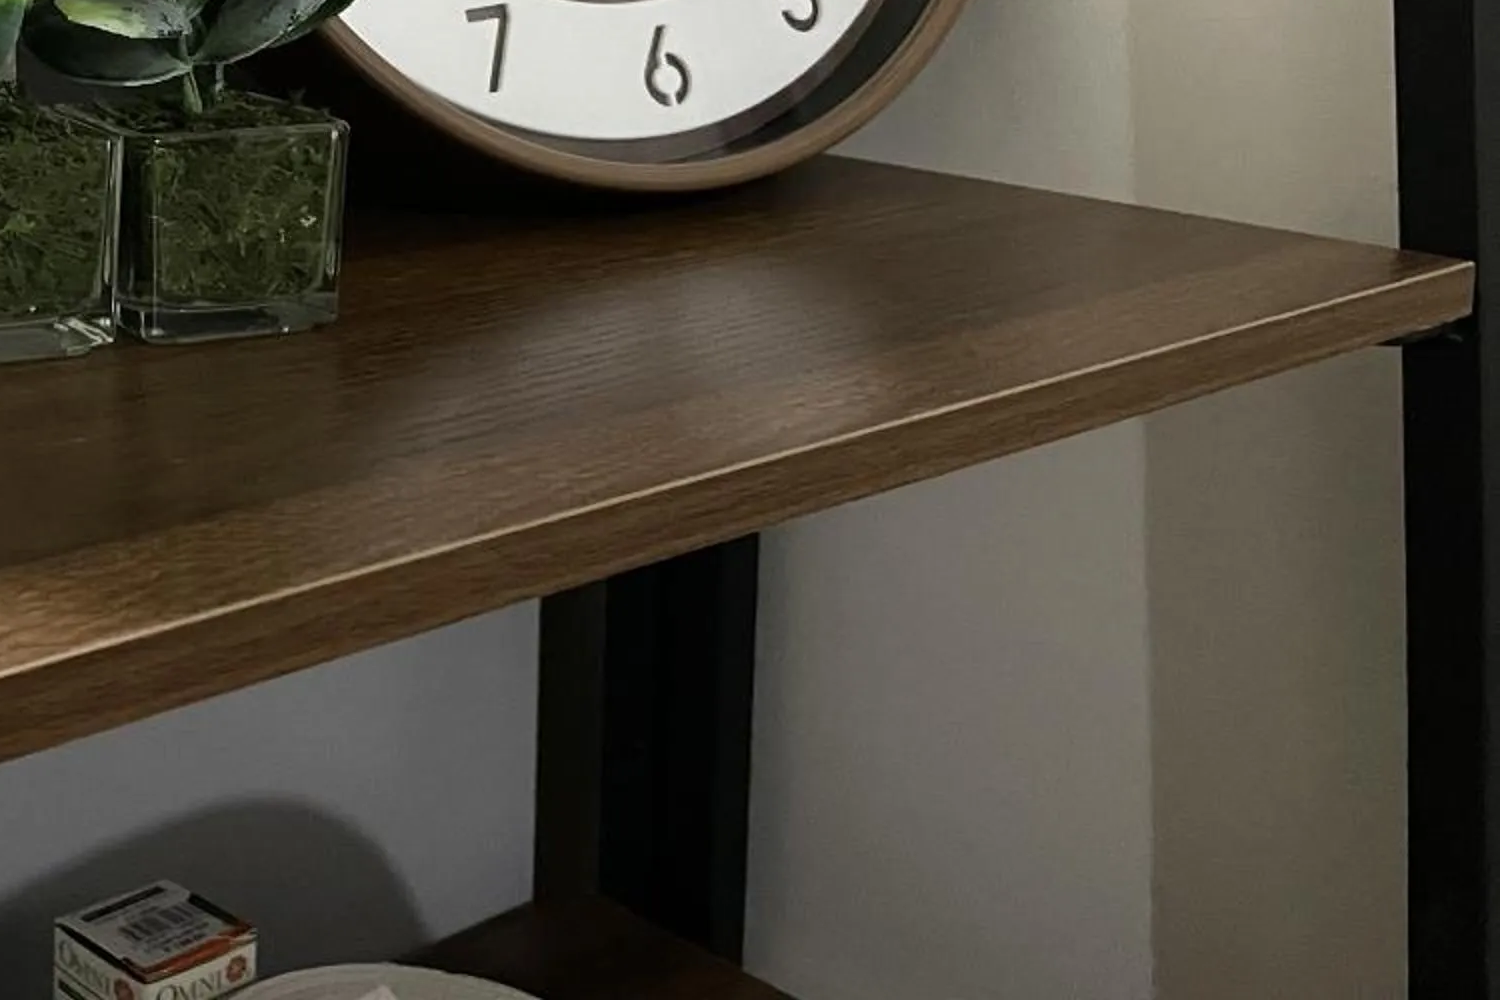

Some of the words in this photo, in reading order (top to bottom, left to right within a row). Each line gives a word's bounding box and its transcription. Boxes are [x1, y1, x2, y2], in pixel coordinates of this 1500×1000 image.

[465, 3, 510, 93] 7
[644, 25, 691, 106] 6
[156, 970, 222, 1000] OMNI
